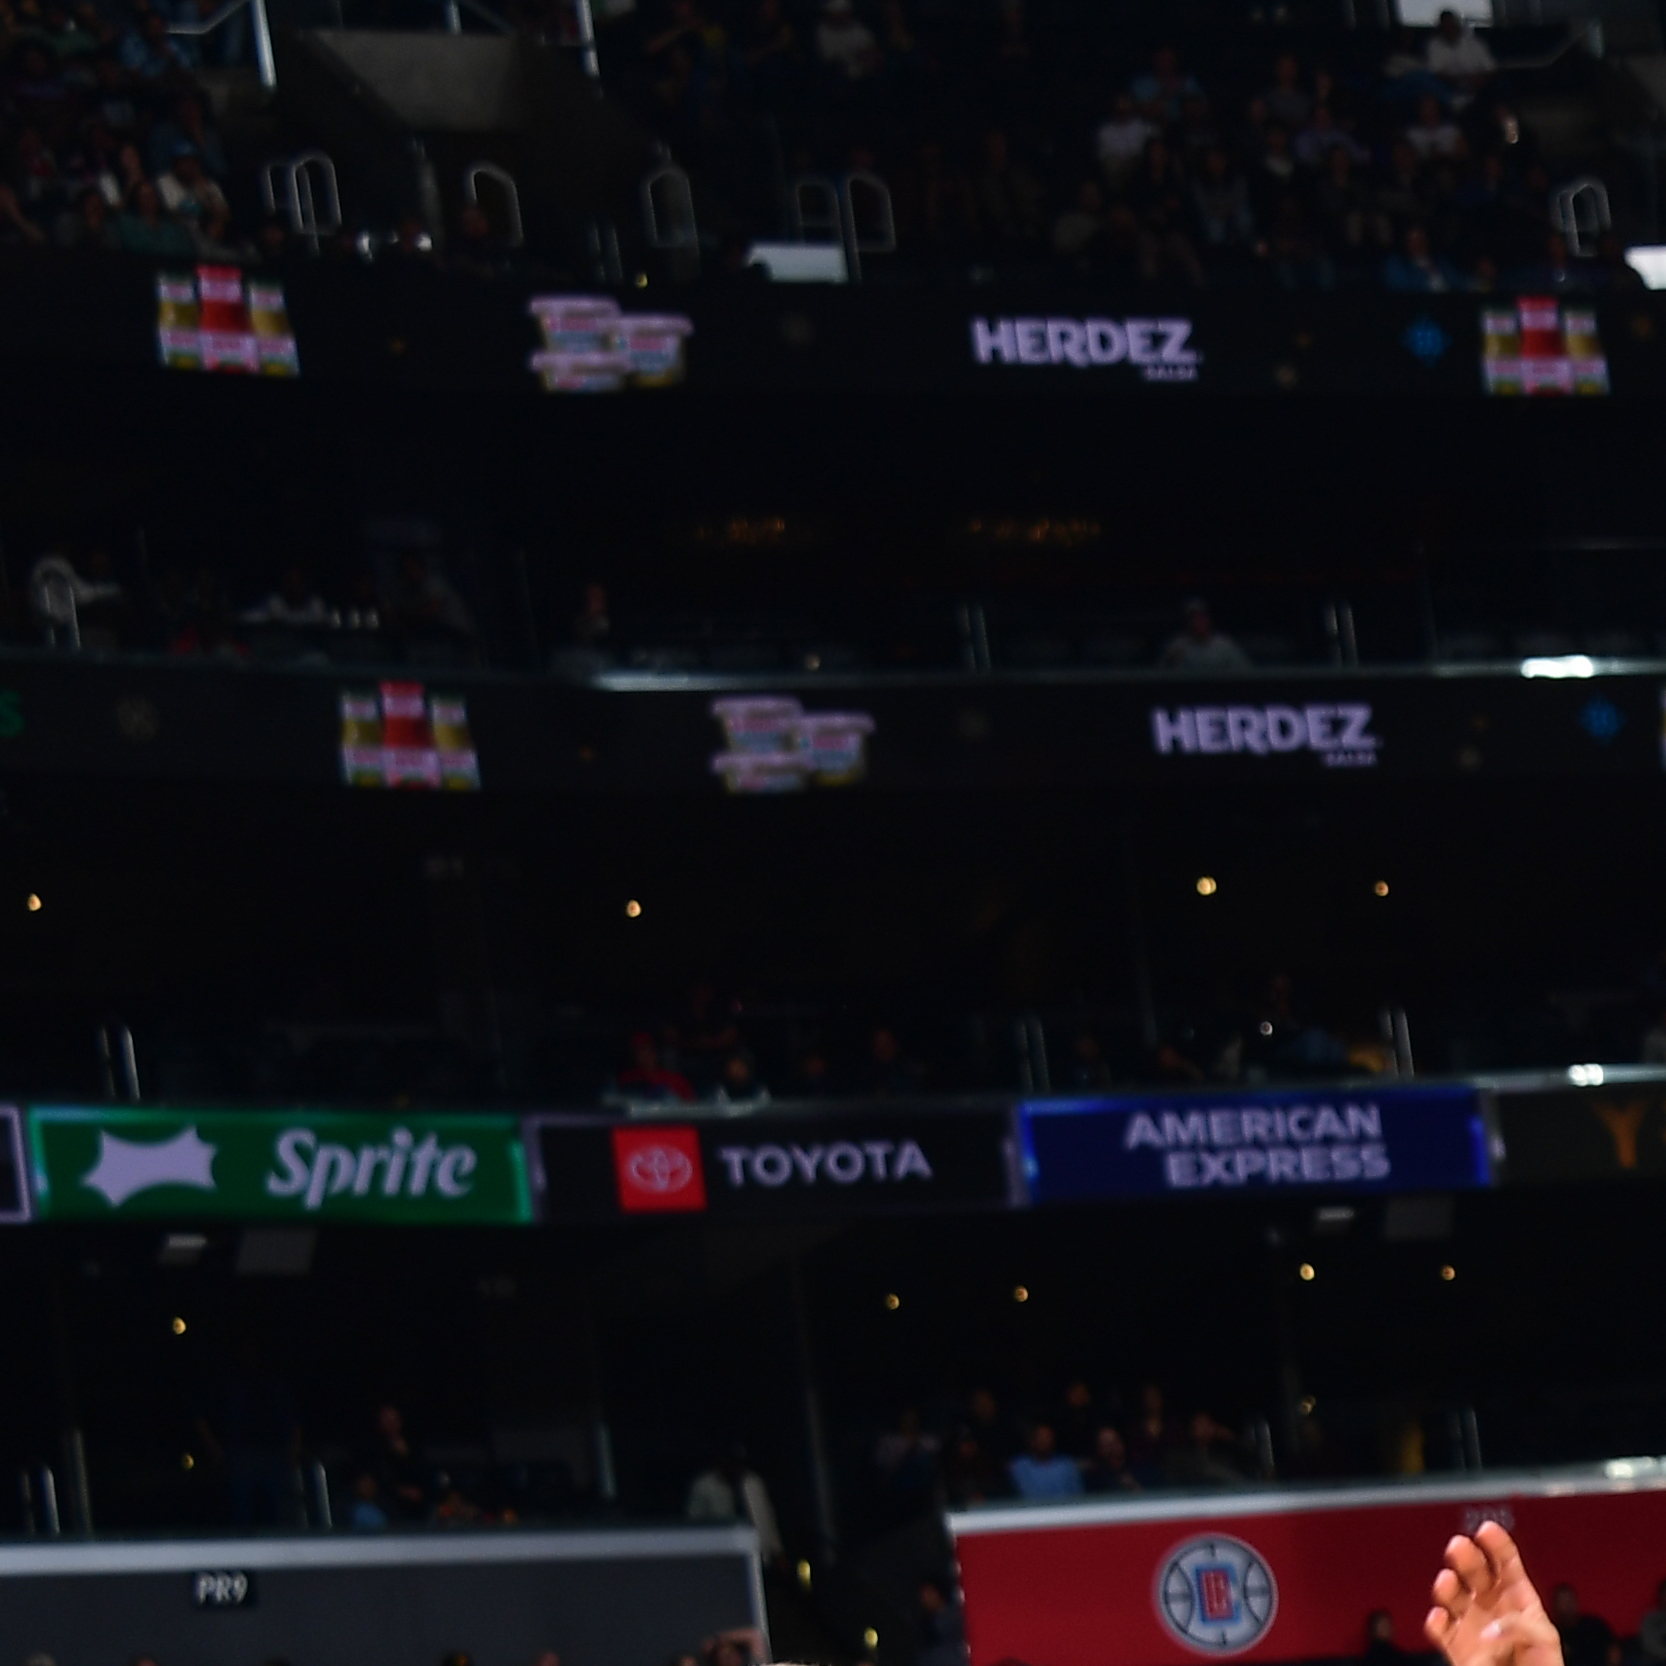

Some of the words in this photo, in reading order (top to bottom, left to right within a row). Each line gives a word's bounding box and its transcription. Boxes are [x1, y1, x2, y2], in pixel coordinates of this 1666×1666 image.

[970, 315, 1200, 367] HERDEZ
[1149, 702, 1382, 756] HERDEZ
[1123, 1105, 1383, 1151] AMERICAN
[267, 1126, 478, 1211] Sprite
[722, 1142, 932, 1188] TOYOTA
[1163, 1144, 1392, 1189] EXPRESS
[196, 1574, 250, 1604] PR9
